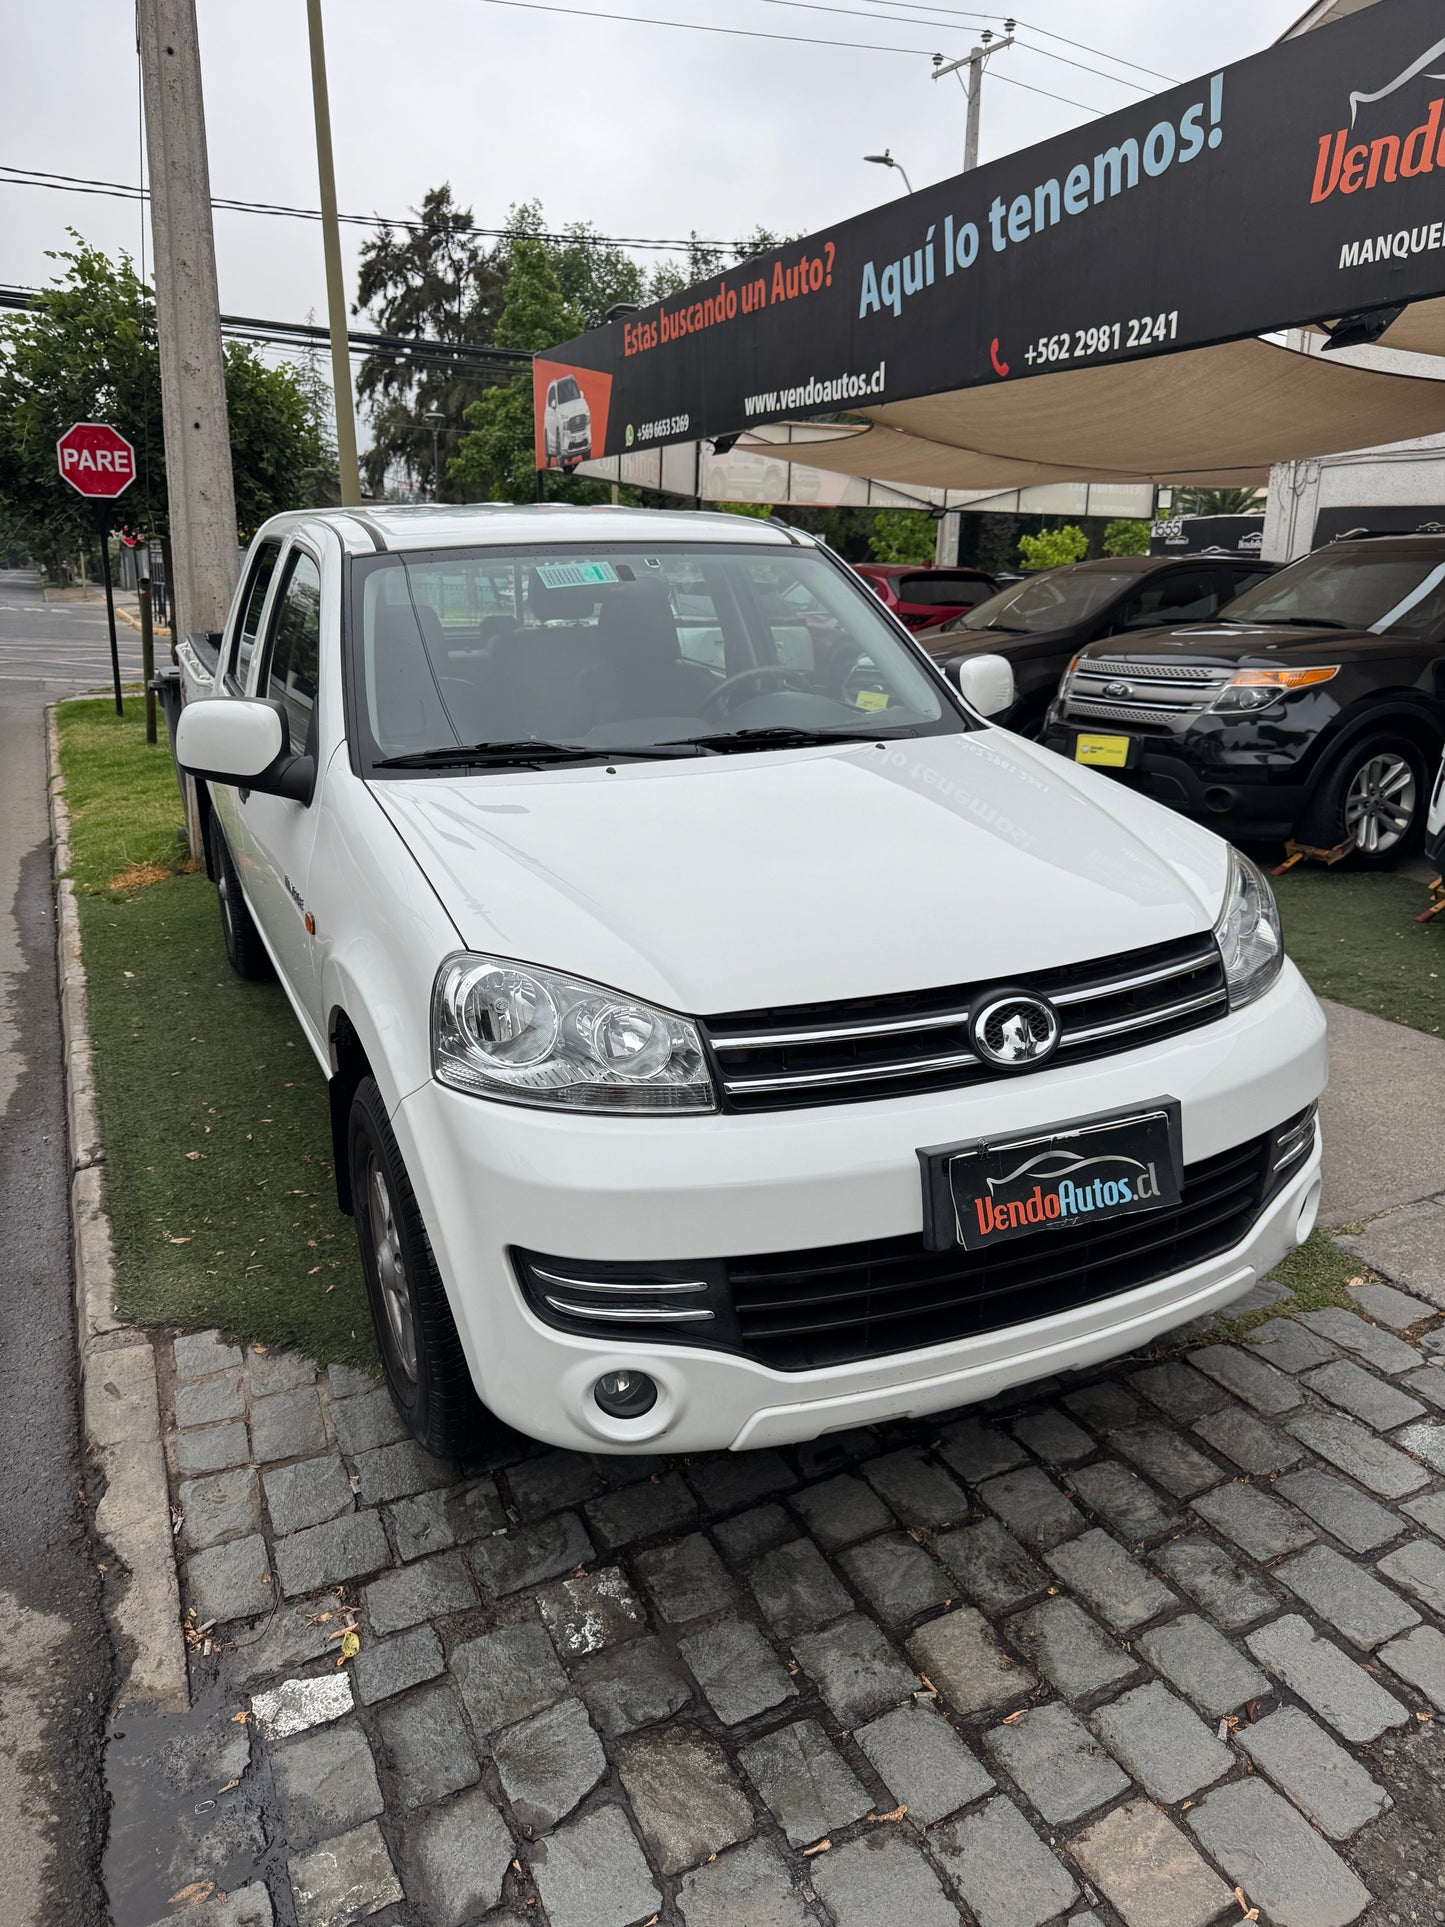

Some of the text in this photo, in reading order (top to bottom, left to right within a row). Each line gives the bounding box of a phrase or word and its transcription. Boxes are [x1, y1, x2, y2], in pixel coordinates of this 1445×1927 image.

[858, 72, 1224, 319] Aquí lo tenemos!
[1338, 222, 1445, 269] MANQUE
[624, 241, 836, 357] Estas buscando un Auto?
[1024, 310, 1178, 366] +562 2981 2241
[744, 361, 886, 416] www.vendoautos.cl
[637, 413, 689, 441] +569 6653 5269
[63, 448, 130, 473] PARE
[975, 1163, 1160, 1235] VendoAutos.cl
